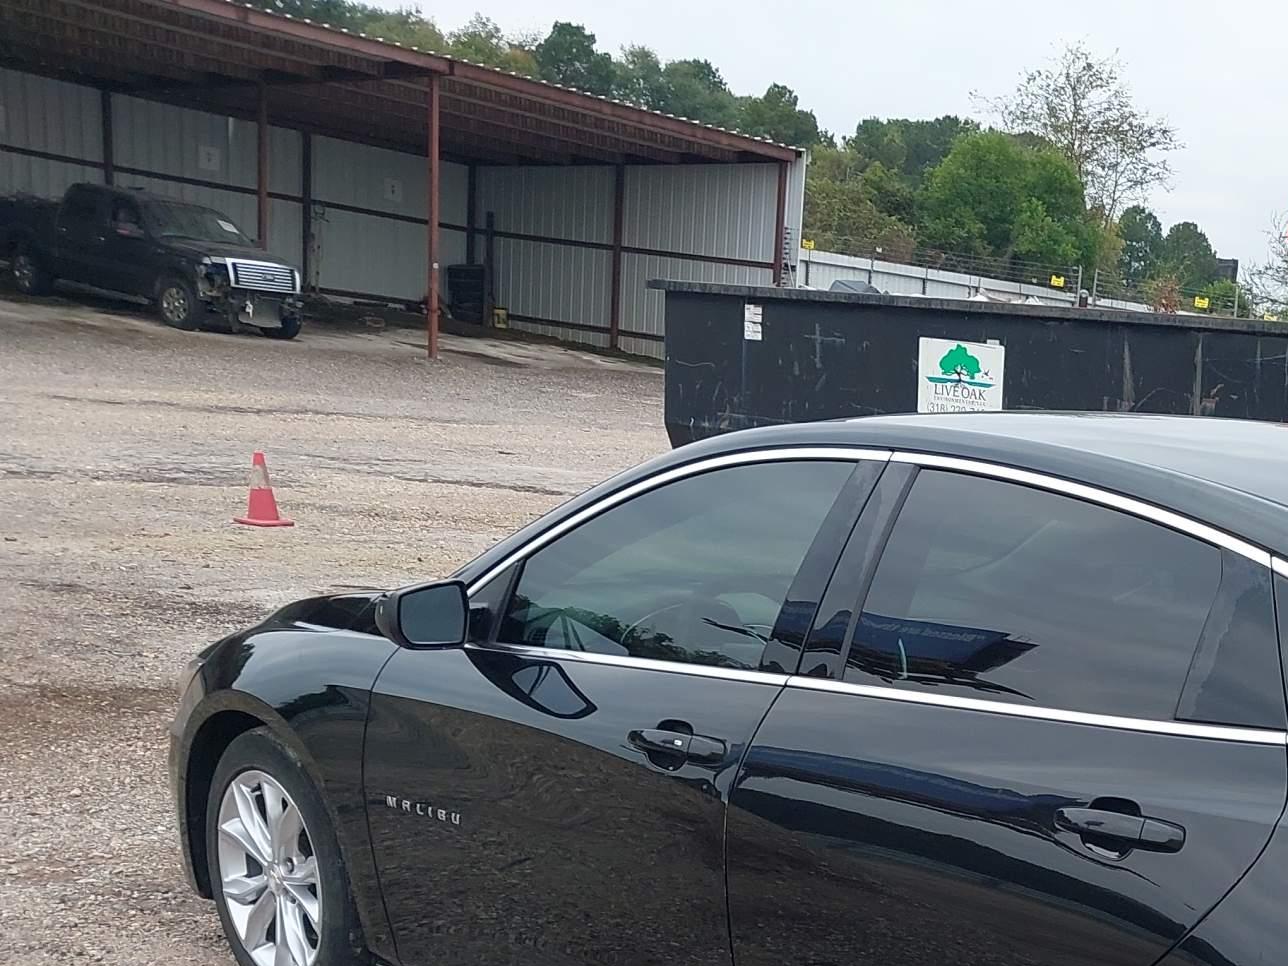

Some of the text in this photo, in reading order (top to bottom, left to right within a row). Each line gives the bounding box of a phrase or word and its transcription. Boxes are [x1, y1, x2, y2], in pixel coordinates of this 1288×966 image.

[934, 384, 986, 401] LIVE OAK
[386, 795, 460, 825] MALIBU
